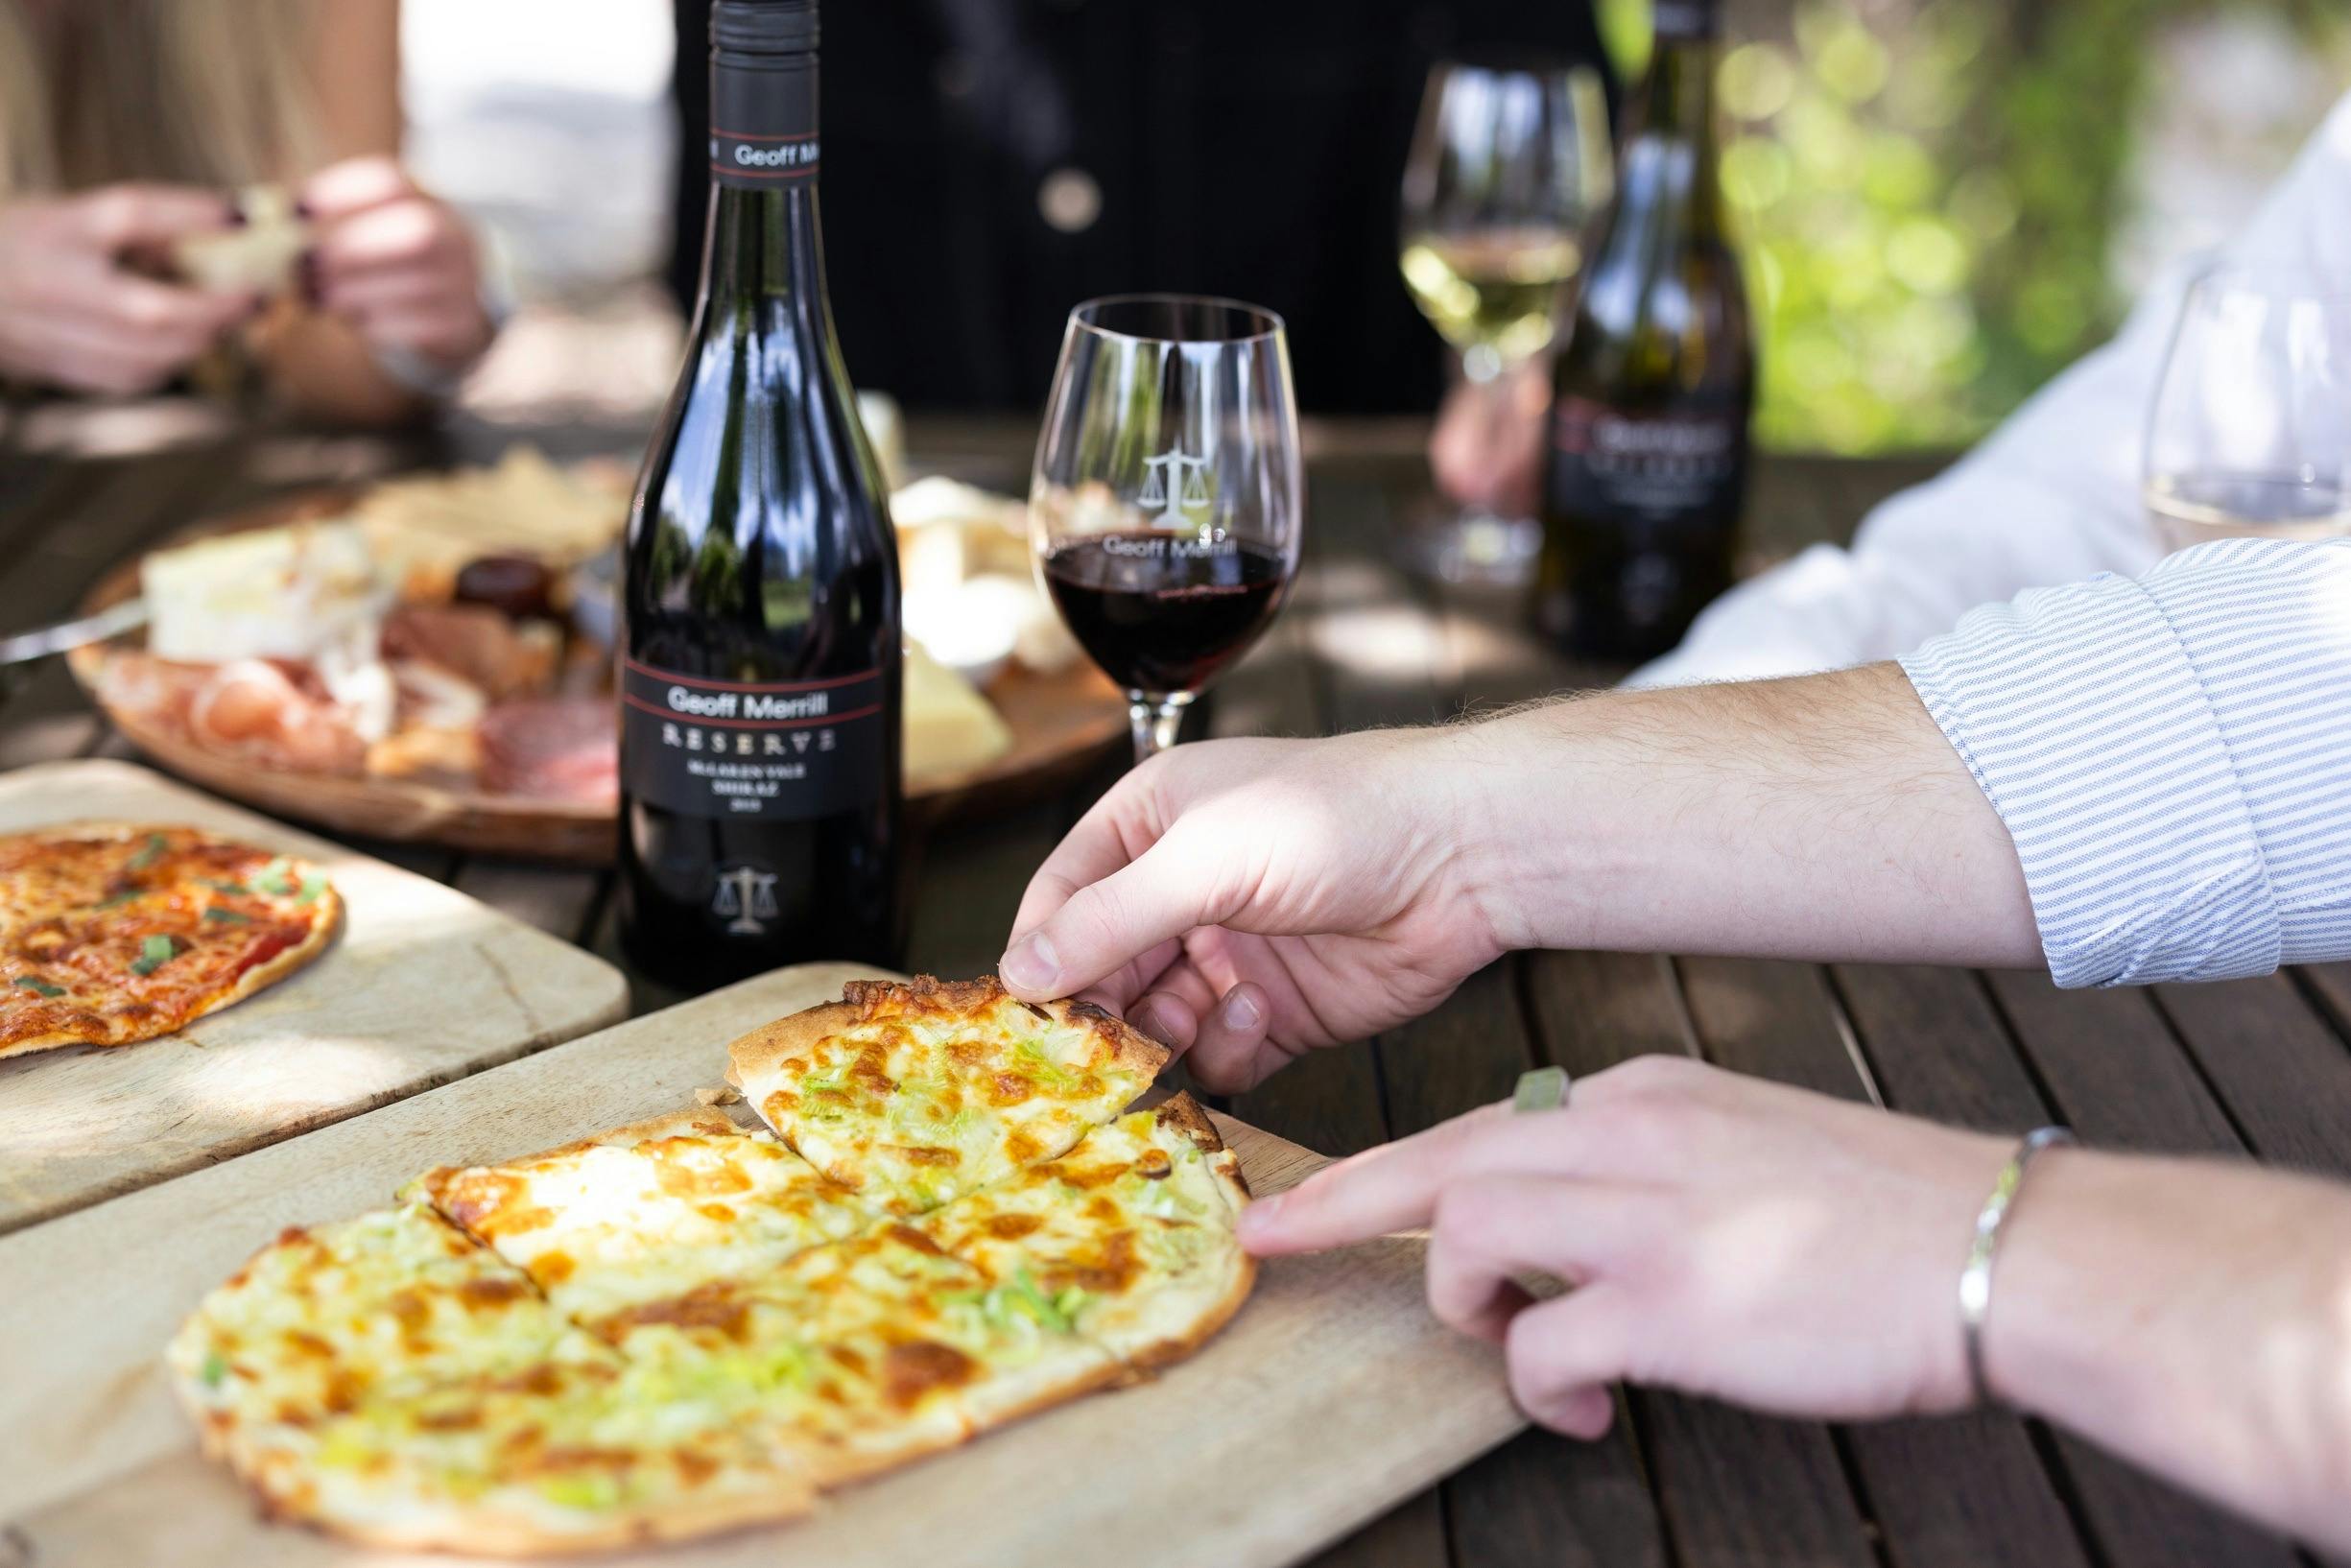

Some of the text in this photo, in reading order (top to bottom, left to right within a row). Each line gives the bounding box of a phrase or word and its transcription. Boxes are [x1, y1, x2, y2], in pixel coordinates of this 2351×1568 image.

[734, 144, 797, 166] Geoff
[1103, 534, 1165, 558] Geoff
[667, 685, 828, 720] Geoff Merrill
[662, 722, 836, 755] RESERVE
